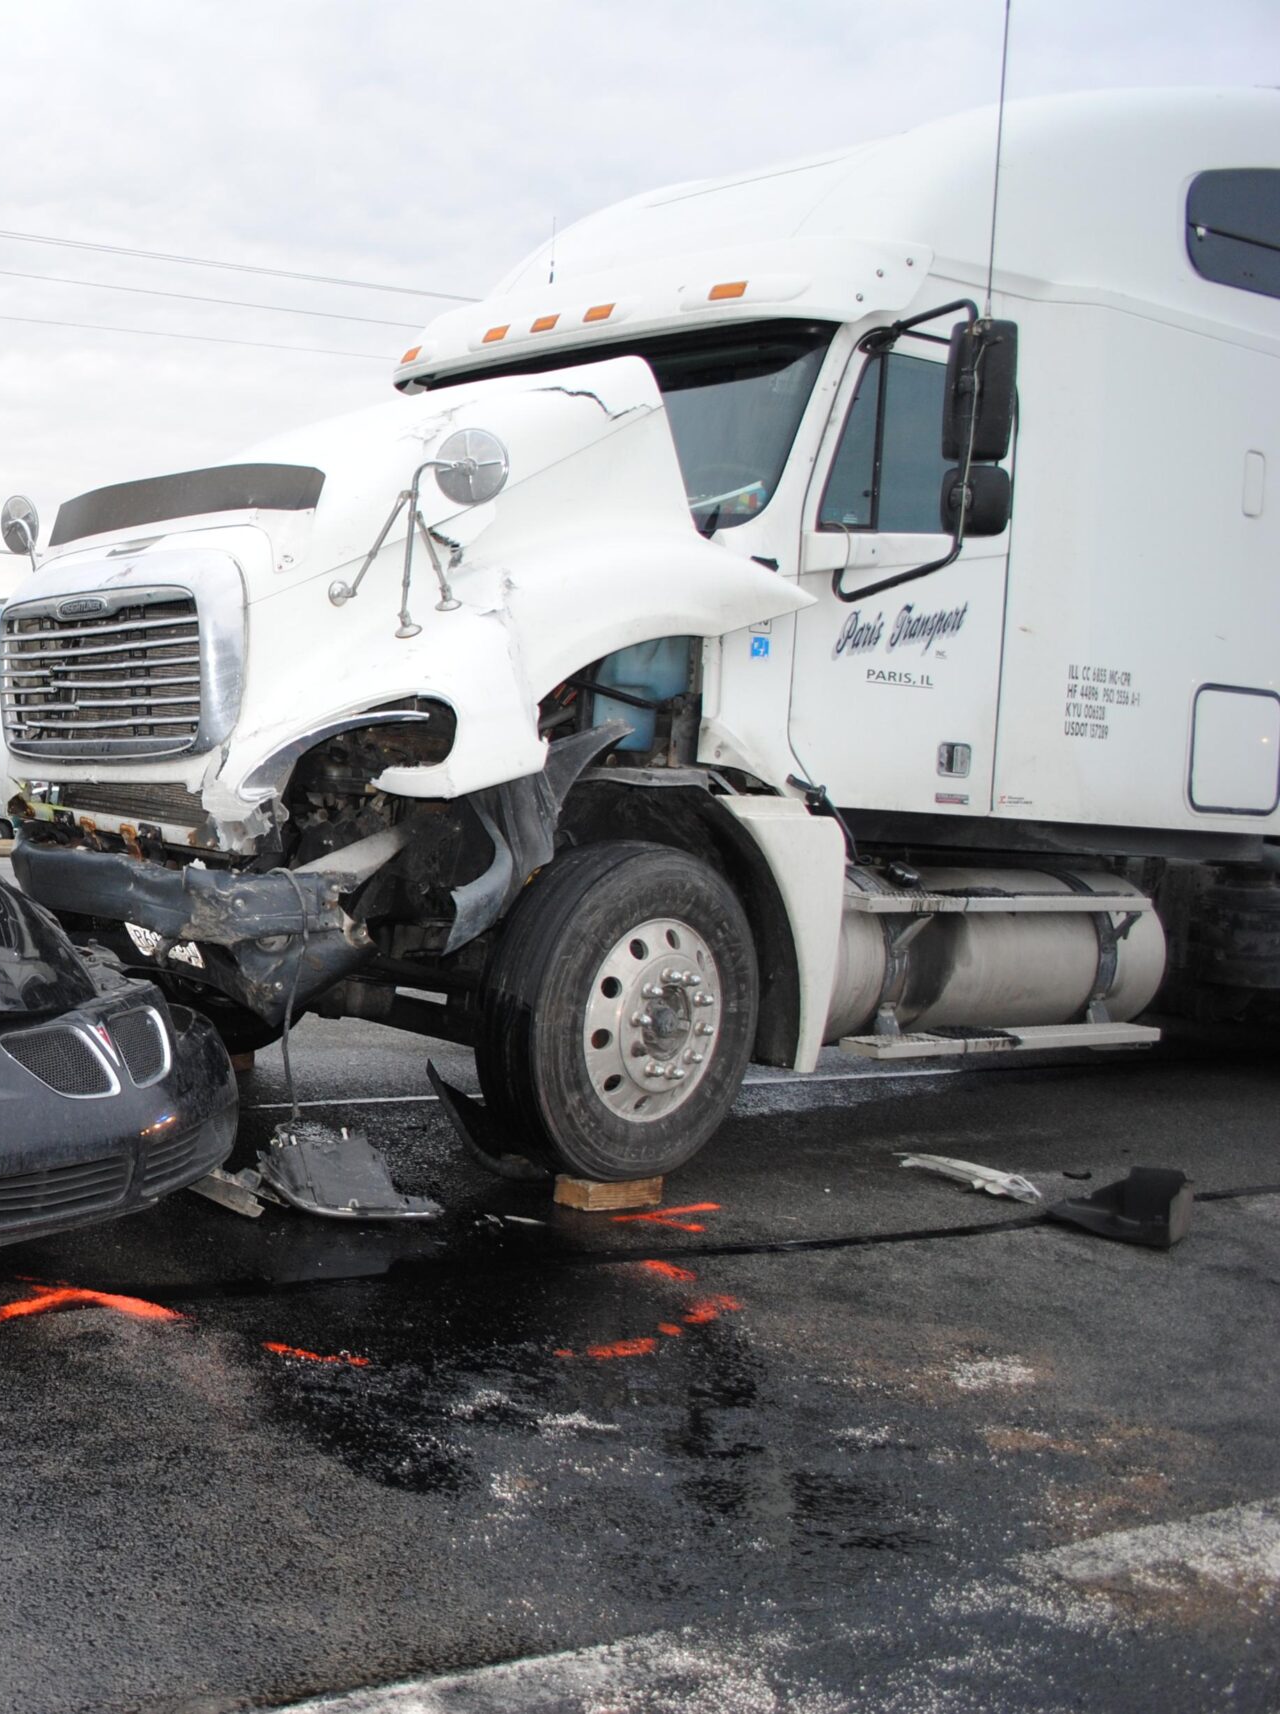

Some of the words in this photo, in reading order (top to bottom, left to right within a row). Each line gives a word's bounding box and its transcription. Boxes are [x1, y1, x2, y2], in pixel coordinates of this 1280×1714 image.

[834, 608, 884, 656] Paris
[888, 600, 968, 654] Transport
[866, 668, 917, 685] PARIS,
[921, 674, 934, 686] IL
[1082, 665, 1091, 681] CC
[1066, 683, 1078, 698] HF
[1065, 702, 1082, 718] KYU
[1064, 720, 1088, 737] USDOT
